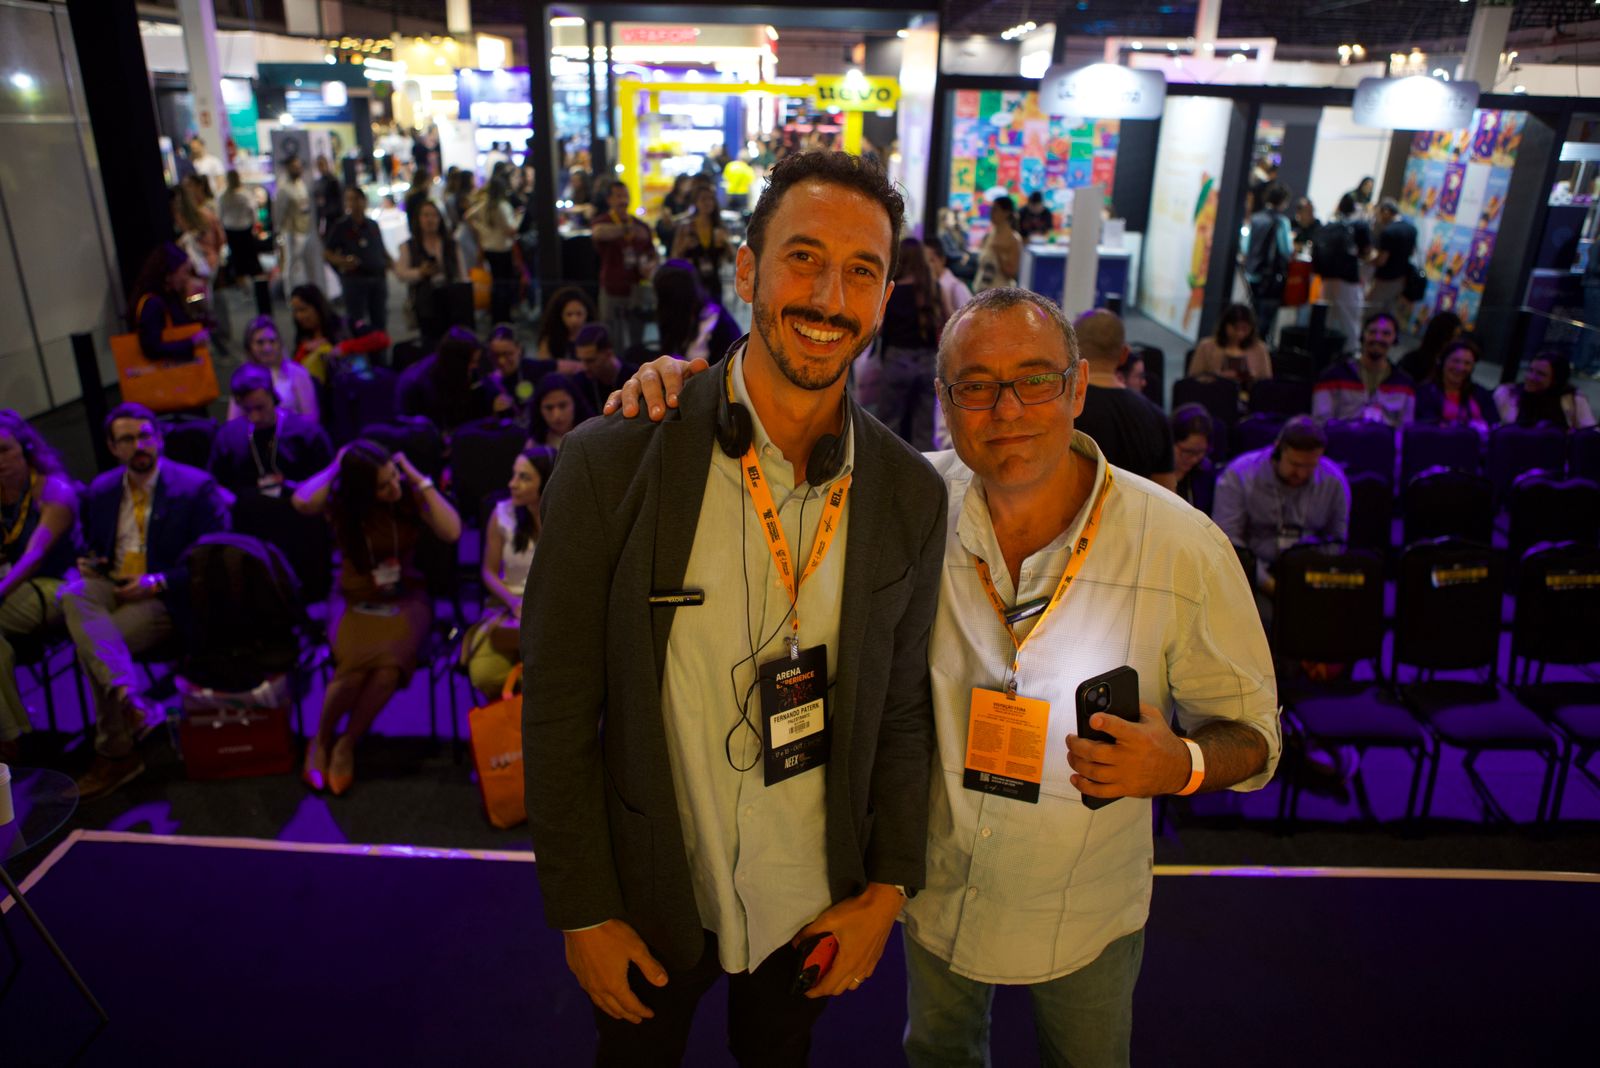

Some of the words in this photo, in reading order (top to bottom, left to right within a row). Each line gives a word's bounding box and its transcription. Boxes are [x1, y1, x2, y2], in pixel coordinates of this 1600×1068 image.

[776, 667, 801, 681] ARENA
[773, 709, 800, 723] FERNANDO
[784, 754, 800, 769] NEEX
